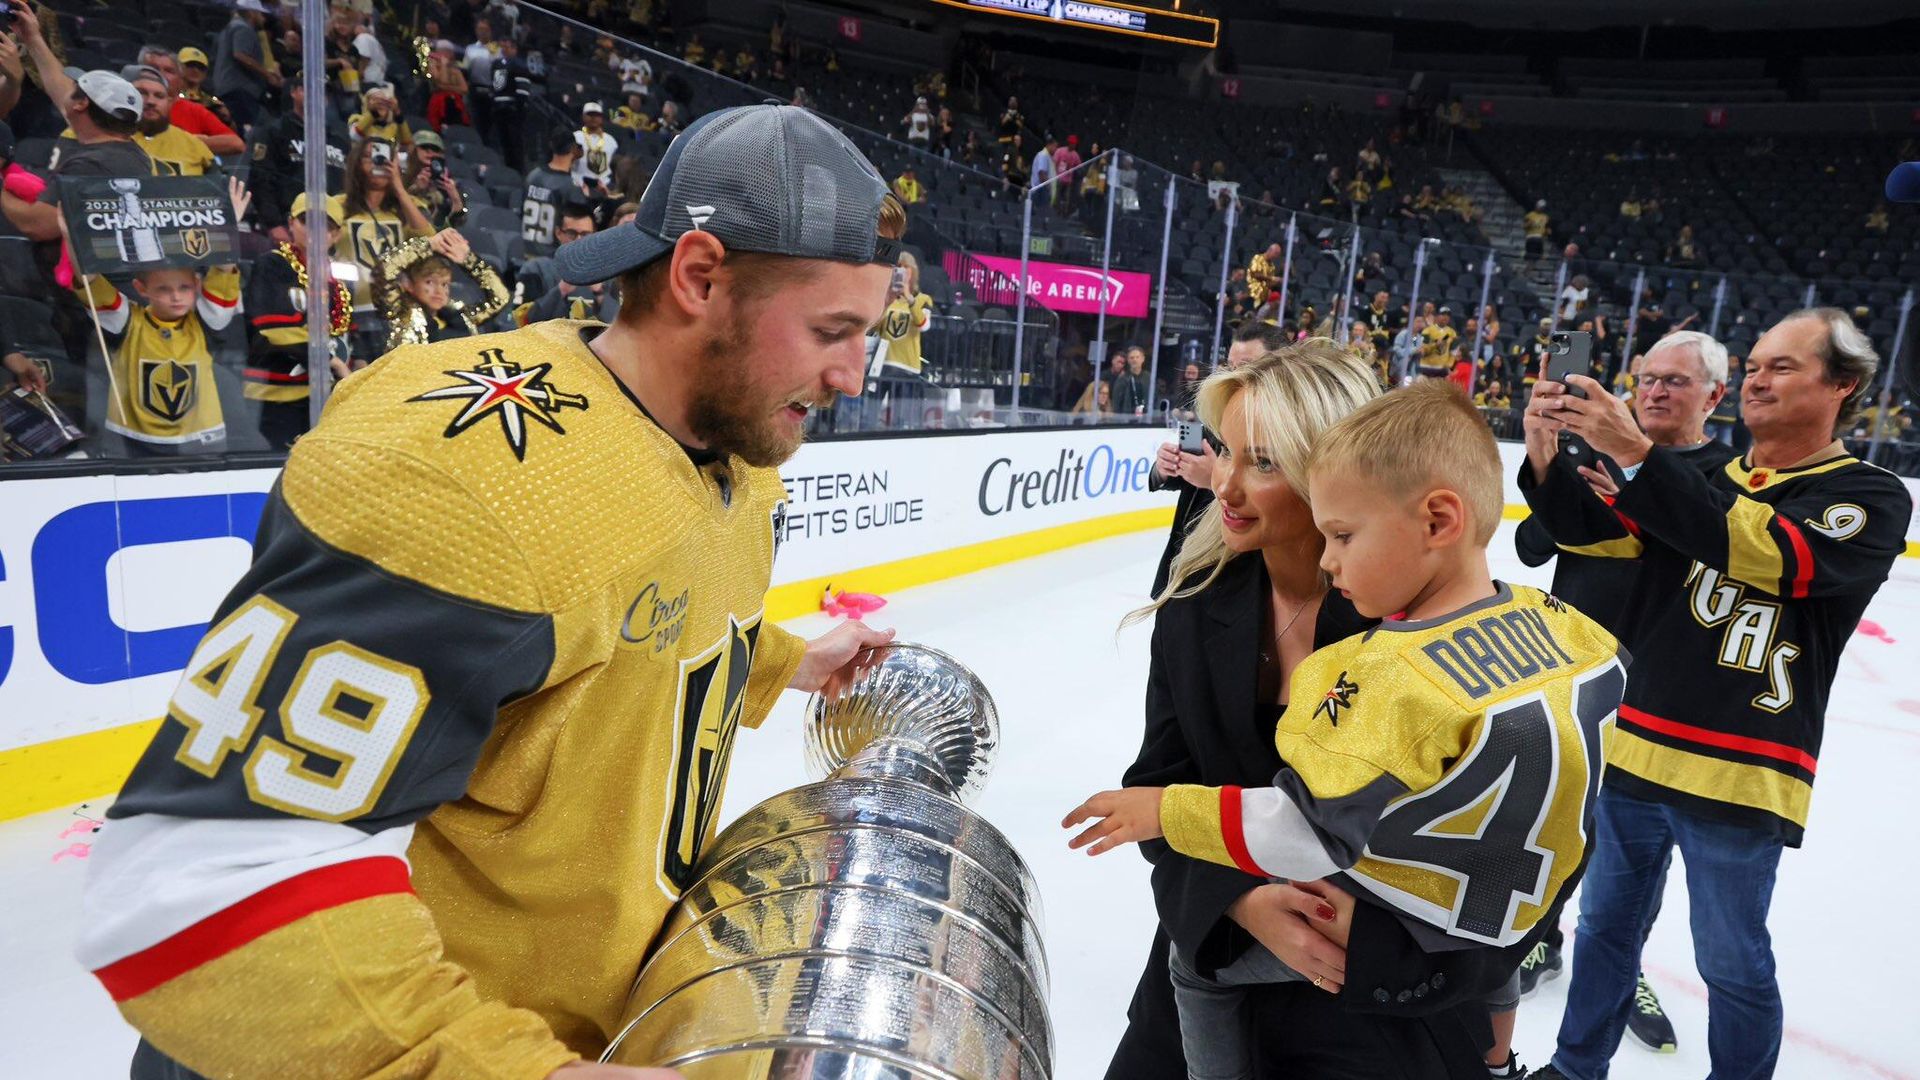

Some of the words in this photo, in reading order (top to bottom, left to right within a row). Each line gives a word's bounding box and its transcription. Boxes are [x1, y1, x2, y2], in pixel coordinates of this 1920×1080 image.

[1064, 3, 1130, 26] CHAMPIONS
[86, 201, 117, 210] 2023
[142, 199, 193, 209] STANLEY
[198, 199, 221, 208] CUP
[87, 209, 226, 231] CHAMPIONS
[522, 199, 555, 245] 29
[1047, 282, 1111, 302] ARENA
[781, 470, 888, 504] ETERAN
[787, 509, 848, 542] FITS
[856, 499, 923, 530] GUIDE
[620, 580, 689, 643] Circa
[1422, 608, 1574, 699] DADDY
[1684, 560, 1801, 714] GAS
[168, 593, 432, 821] 49
